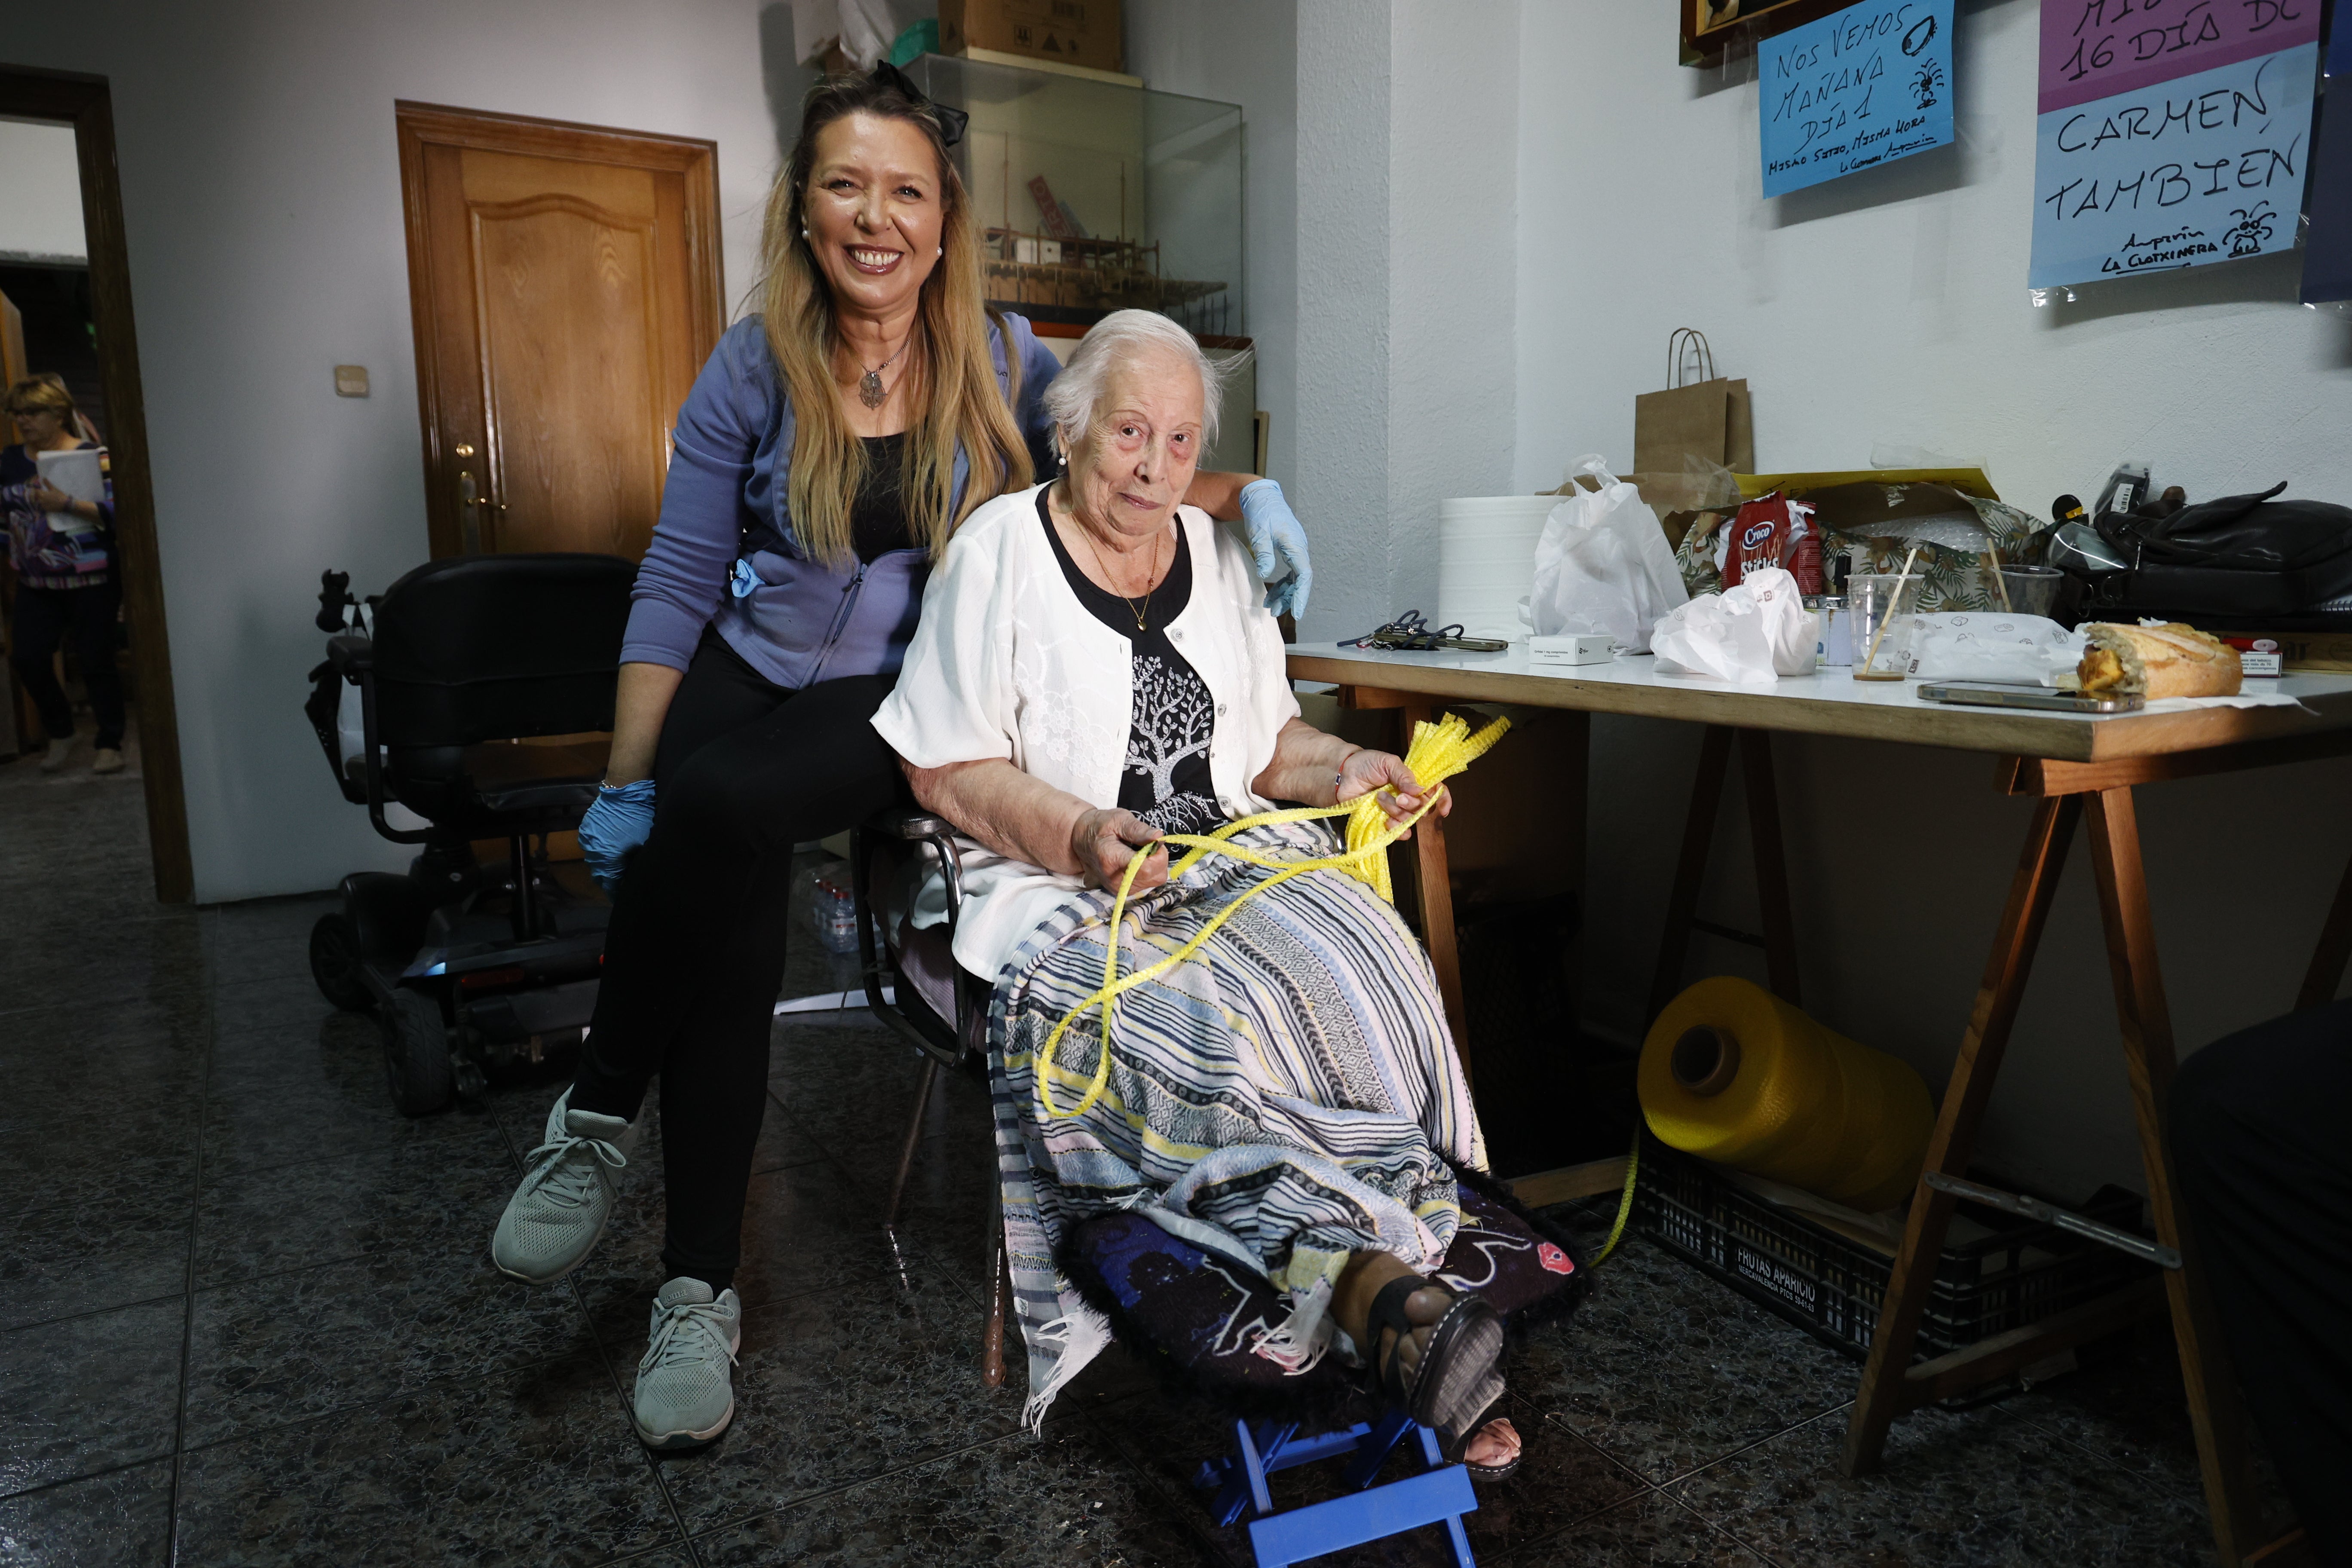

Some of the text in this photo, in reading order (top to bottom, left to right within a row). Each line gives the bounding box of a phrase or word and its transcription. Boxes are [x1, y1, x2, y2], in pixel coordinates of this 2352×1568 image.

[1777, 3, 1913, 79] NOS VEMOS
[2060, 35, 2114, 81] 16
[2128, 1, 2220, 60] DÍA
[2074, 0, 2160, 36] MI
[1773, 47, 1883, 122] MAÑANA
[1854, 85, 1871, 119] 1
[1768, 115, 1926, 175] MISMO SITIO, MISMA HORA
[2128, 242, 2217, 267] CLOTXINERA
[1738, 1248, 1815, 1302] FRUTAS APARICIO
[1739, 1265, 1779, 1293] MERCAVALENCIA
[1795, 1295, 1814, 1313] 59-61-63
